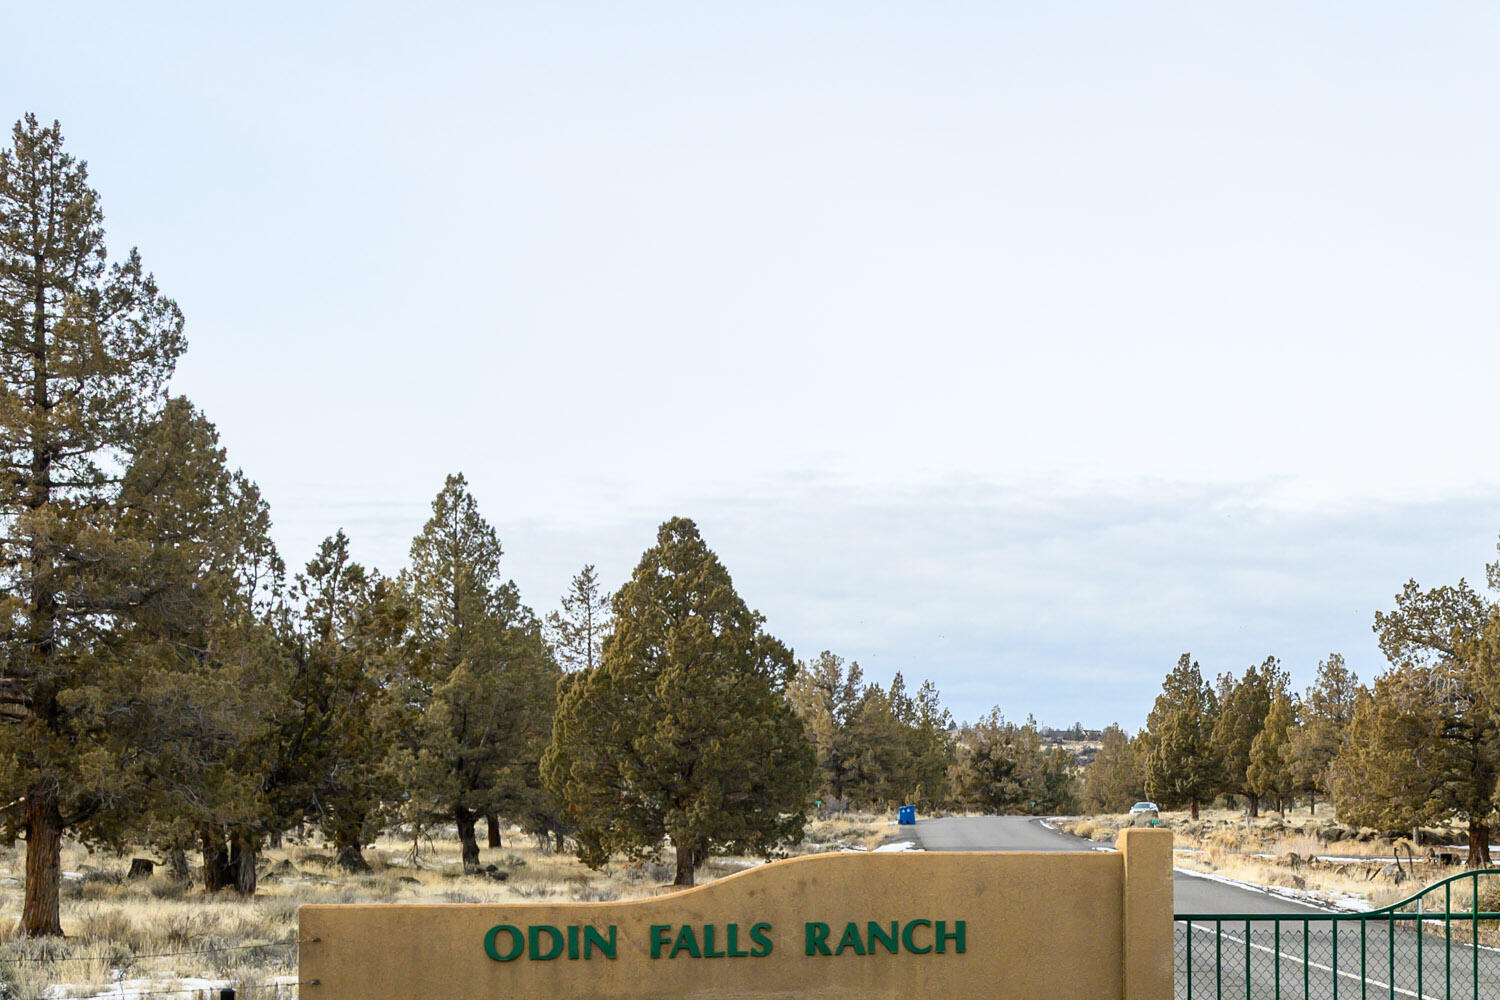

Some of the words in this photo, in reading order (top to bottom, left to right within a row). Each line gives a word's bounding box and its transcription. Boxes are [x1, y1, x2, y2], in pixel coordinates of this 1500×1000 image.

[483, 923, 617, 962] ODIN
[650, 922, 773, 958] FALLS
[805, 918, 967, 956] RANCH
